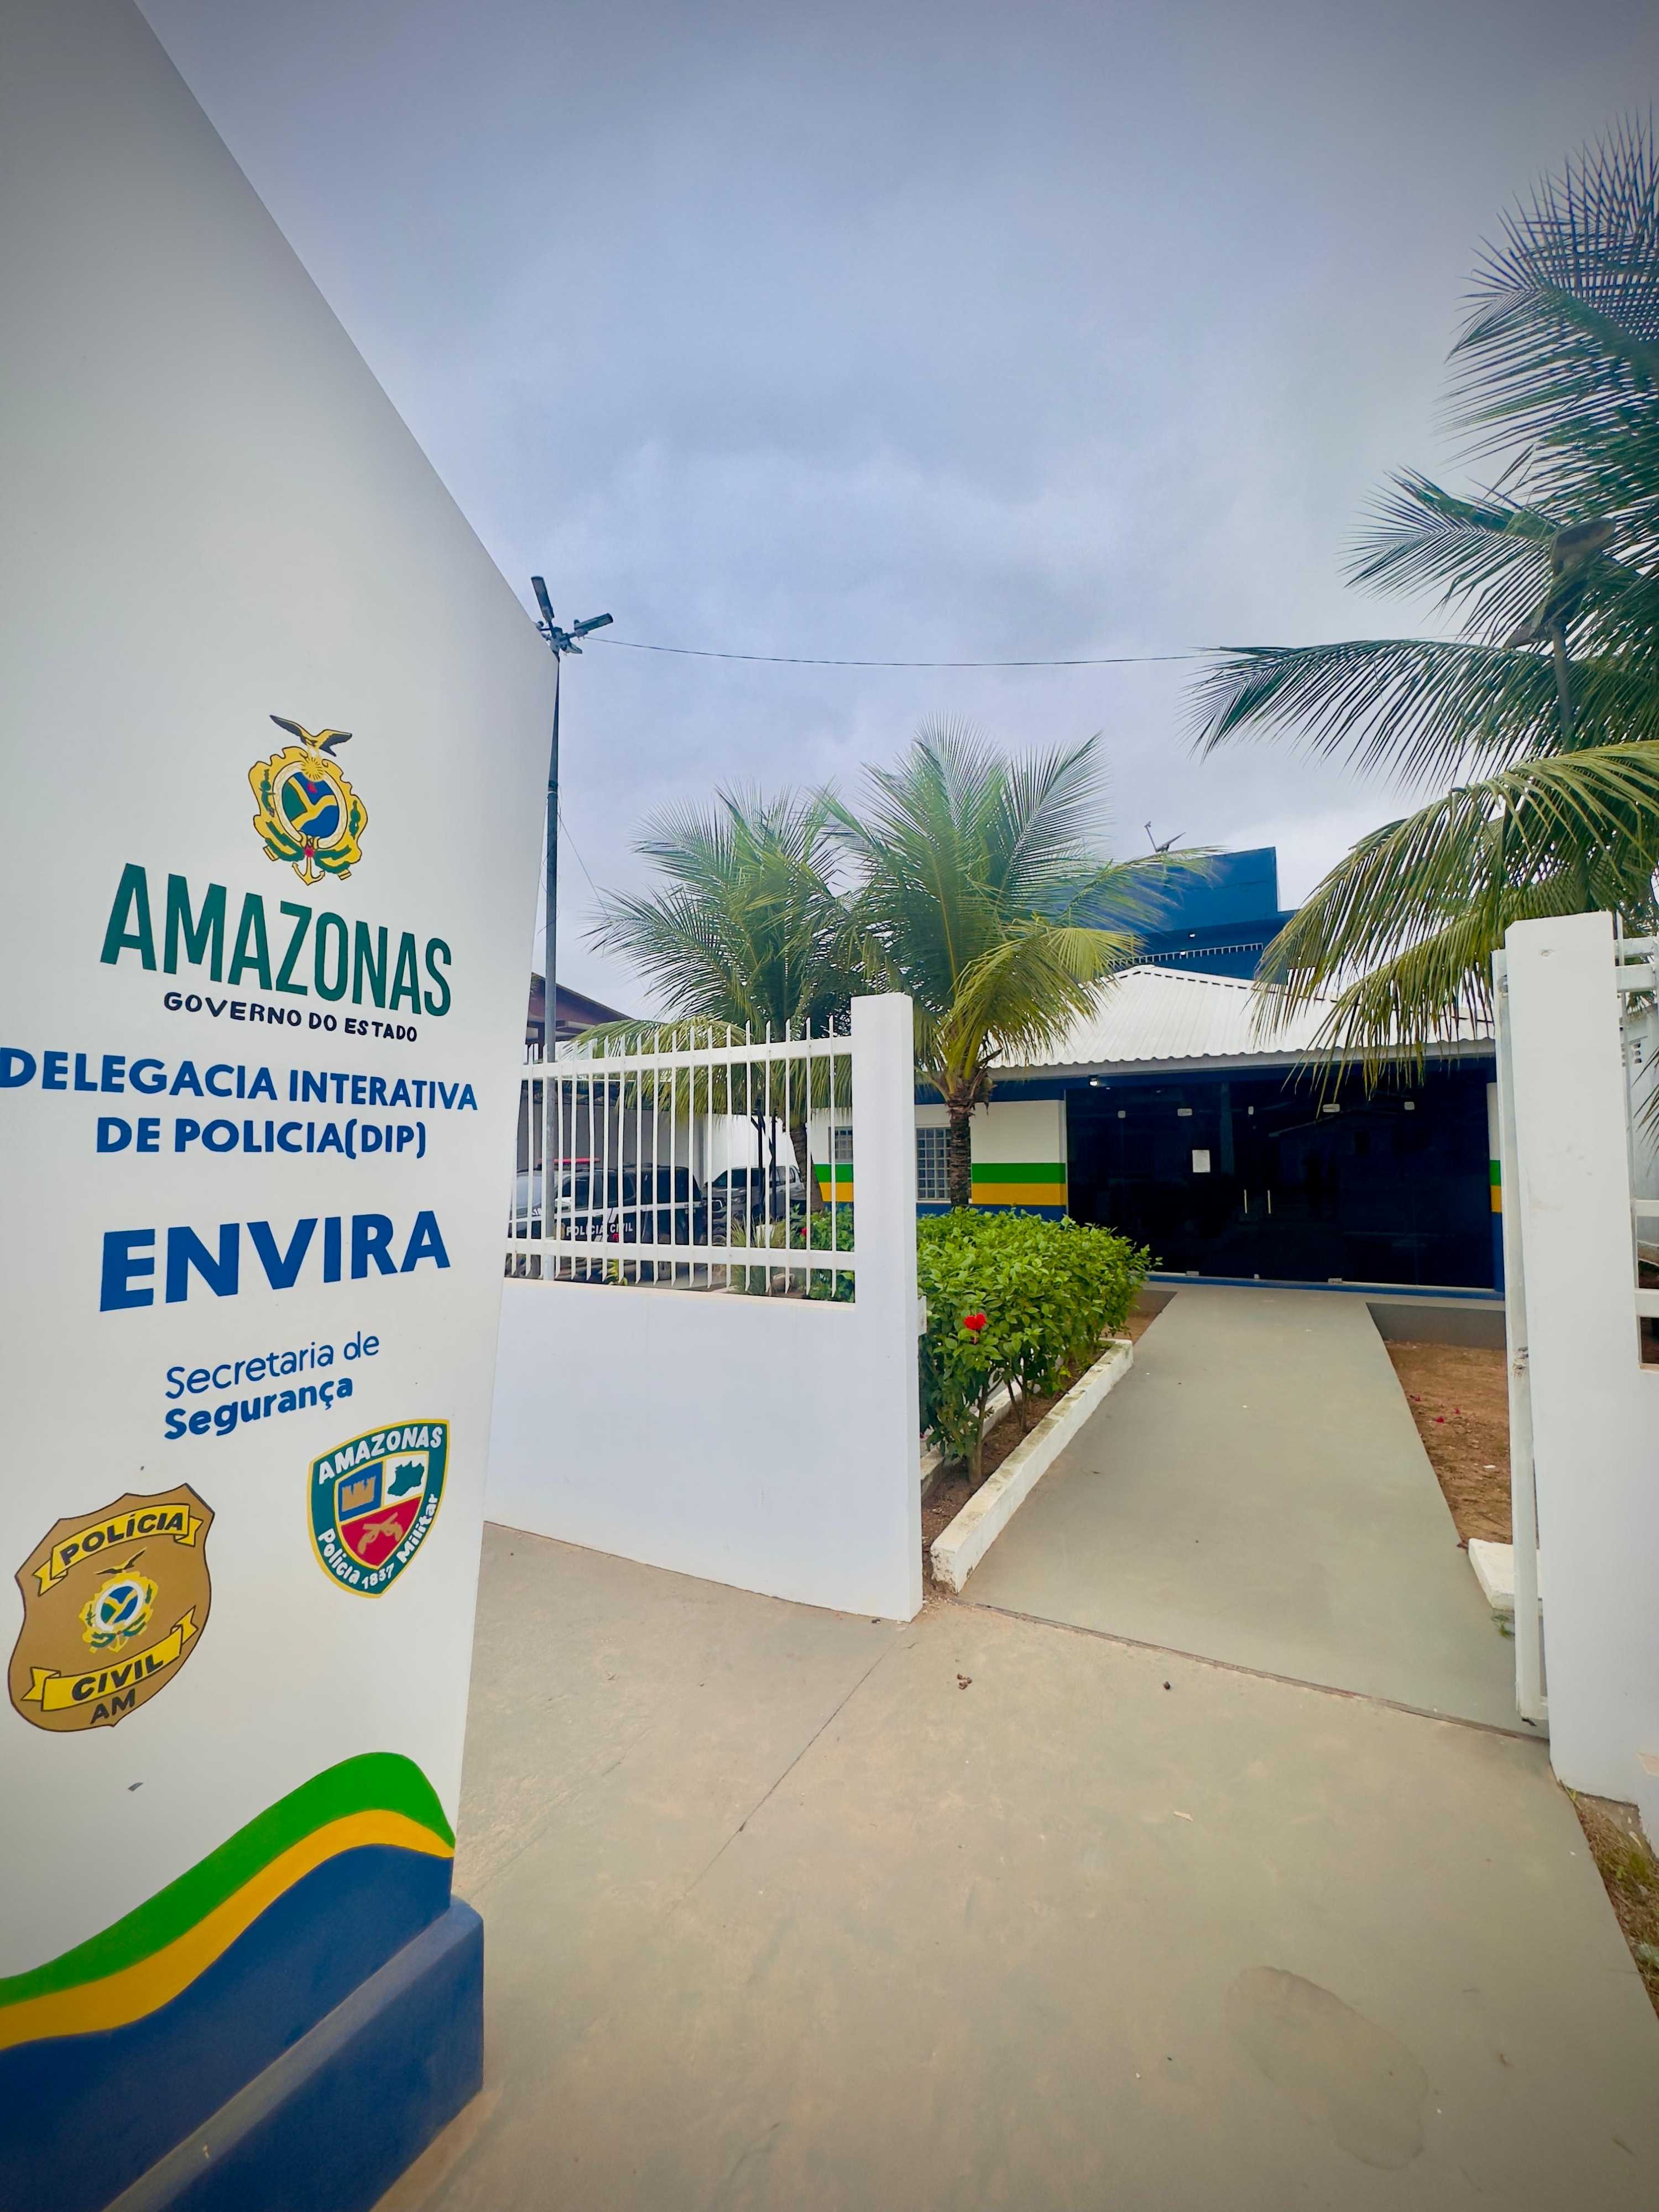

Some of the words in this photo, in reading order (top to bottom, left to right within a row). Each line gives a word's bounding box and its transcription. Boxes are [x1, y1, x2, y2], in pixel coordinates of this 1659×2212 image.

[100, 862, 452, 1016] AMAZONAS
[164, 991, 302, 1027] GOVERNO
[309, 1012, 337, 1031] DO
[345, 1018, 418, 1042] ESTADO
[0, 1047, 278, 1101] DELEGACIA
[289, 1069, 478, 1112] INTERATIVA
[96, 1116, 161, 1154] DE
[566, 1224, 604, 1237] POLCIA
[100, 1209, 451, 1313] ENVIRA
[165, 1342, 335, 1400] Secretaria
[343, 1331, 380, 1360] de
[164, 1377, 354, 1440] Segurança
[319, 1426, 443, 1485] AMAZONAS
[59, 1512, 183, 1566] POLÍCIA
[361, 1562, 395, 1590] 1837
[396, 1493, 439, 1564] Militar
[71, 1653, 164, 1702] CIVIL
[90, 1688, 137, 1725] AM
